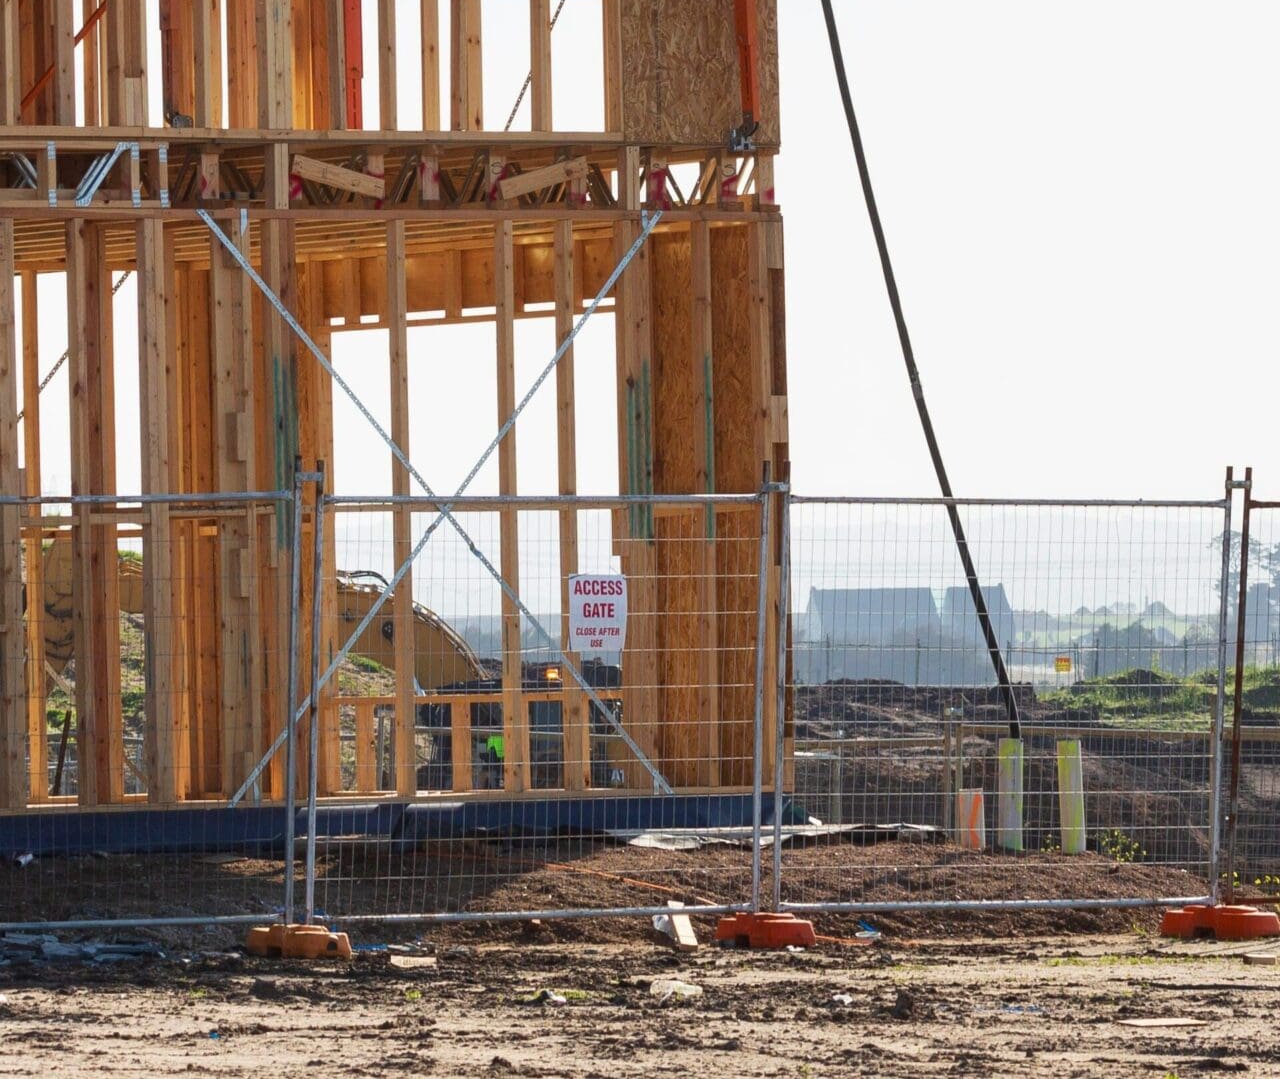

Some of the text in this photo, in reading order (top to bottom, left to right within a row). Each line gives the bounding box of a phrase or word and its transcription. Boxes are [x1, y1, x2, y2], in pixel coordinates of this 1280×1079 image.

[574, 580, 623, 595] ACCESS
[583, 602, 615, 618] GATE
[576, 627, 620, 636] CLOSE AFTER
[590, 639, 603, 648] USE
